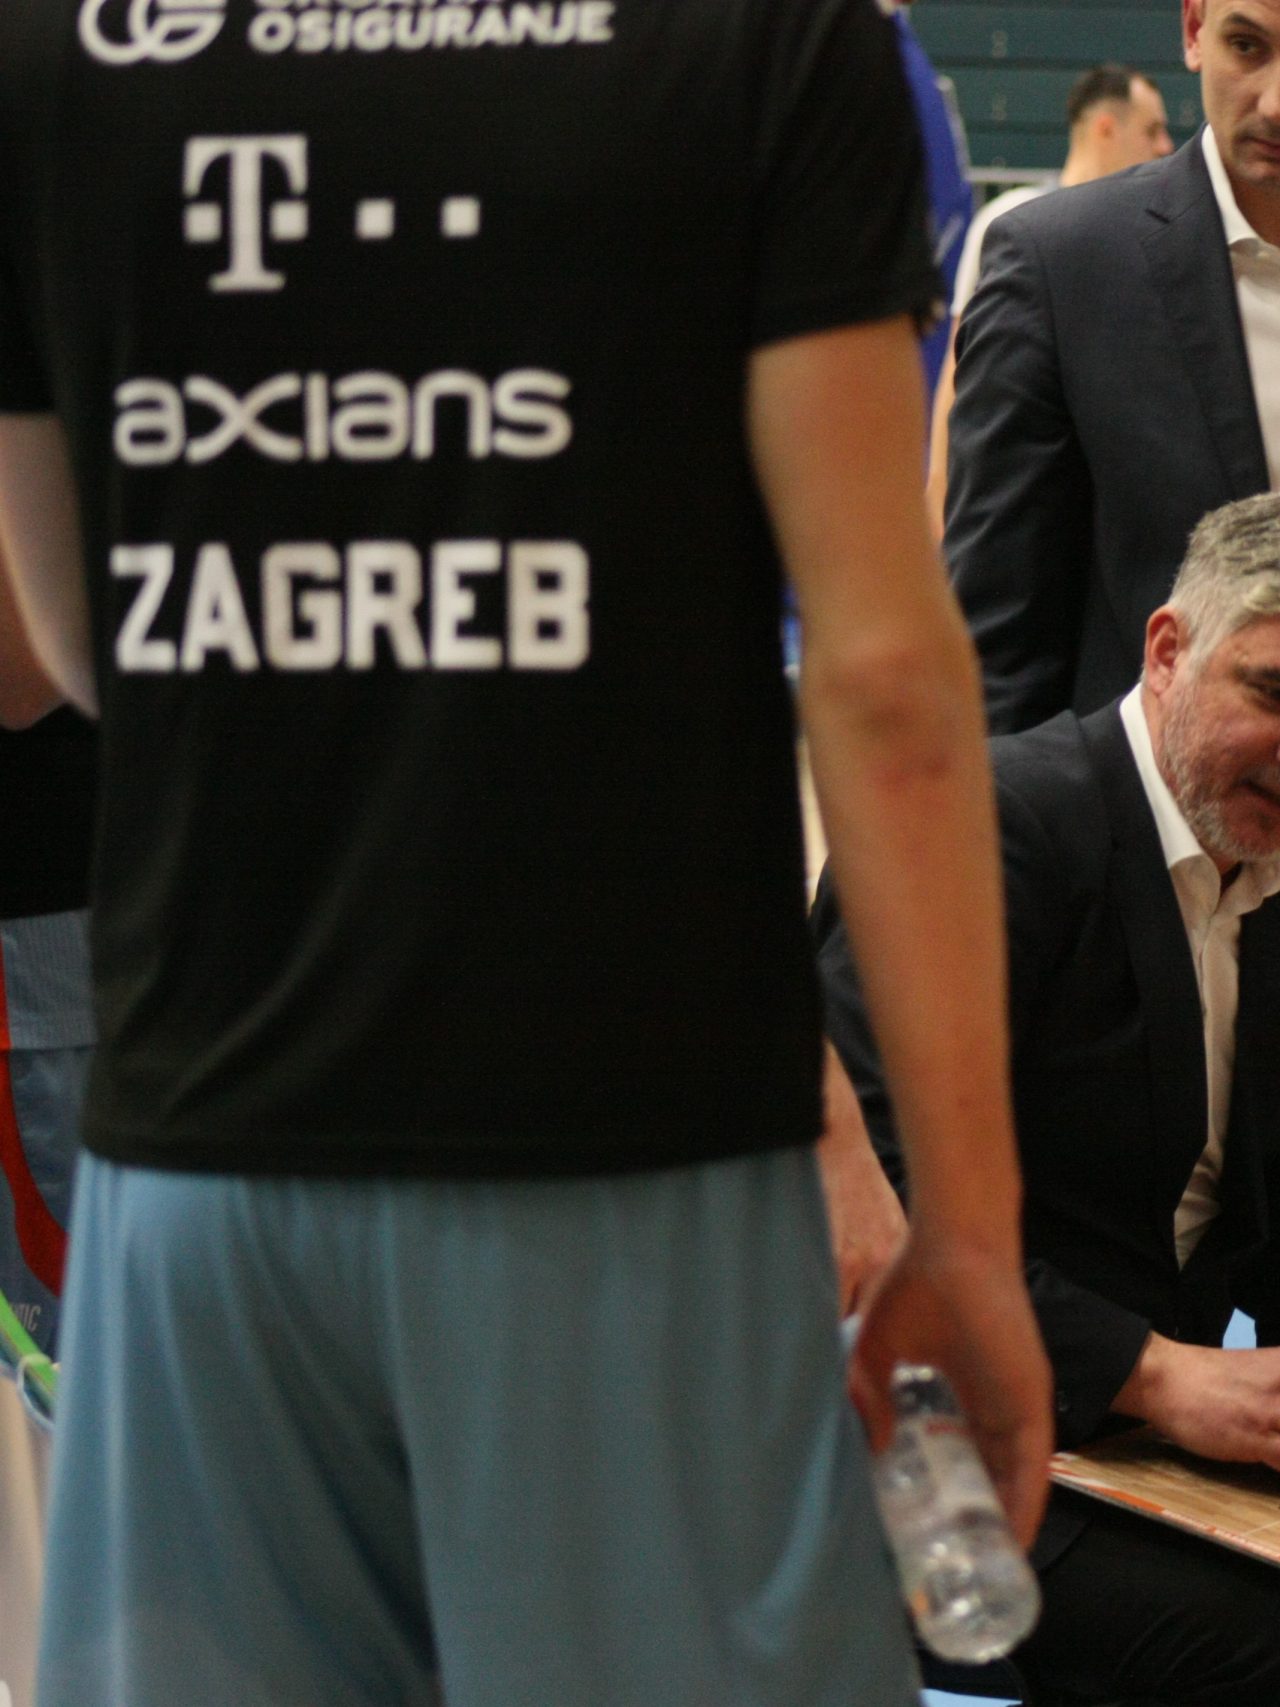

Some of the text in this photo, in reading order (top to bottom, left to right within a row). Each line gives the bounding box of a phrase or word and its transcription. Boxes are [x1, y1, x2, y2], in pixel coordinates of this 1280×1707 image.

[247, 3, 615, 54] OSIGURANJE
[184, 134, 308, 293] T
[113, 368, 573, 467] axians
[109, 539, 591, 673] ZAGREB
